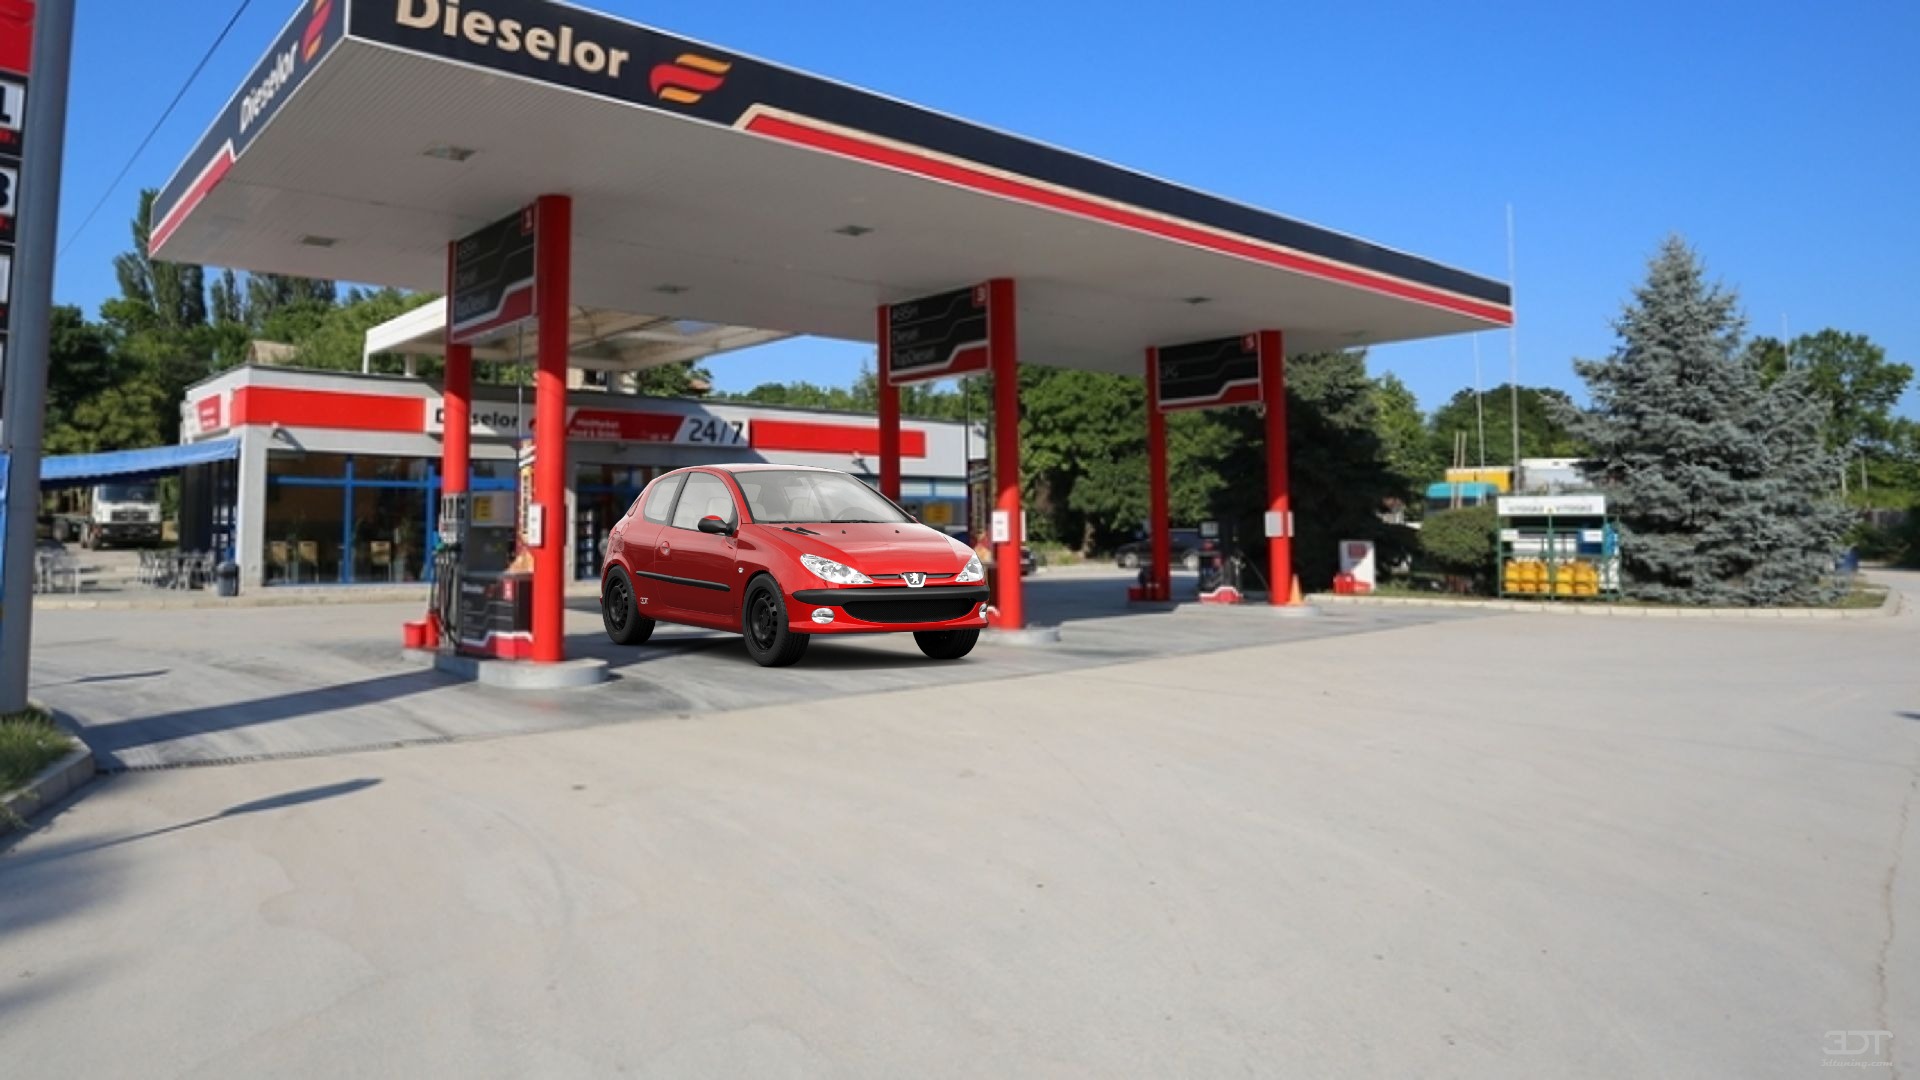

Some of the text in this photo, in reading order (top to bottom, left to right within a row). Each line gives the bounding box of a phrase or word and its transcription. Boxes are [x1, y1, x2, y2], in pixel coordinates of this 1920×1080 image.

[395, 0, 630, 78] Dieselor
[238, 40, 298, 134] Dieselor
[436, 408, 519, 428] Dselor
[689, 418, 744, 445] 24/7
